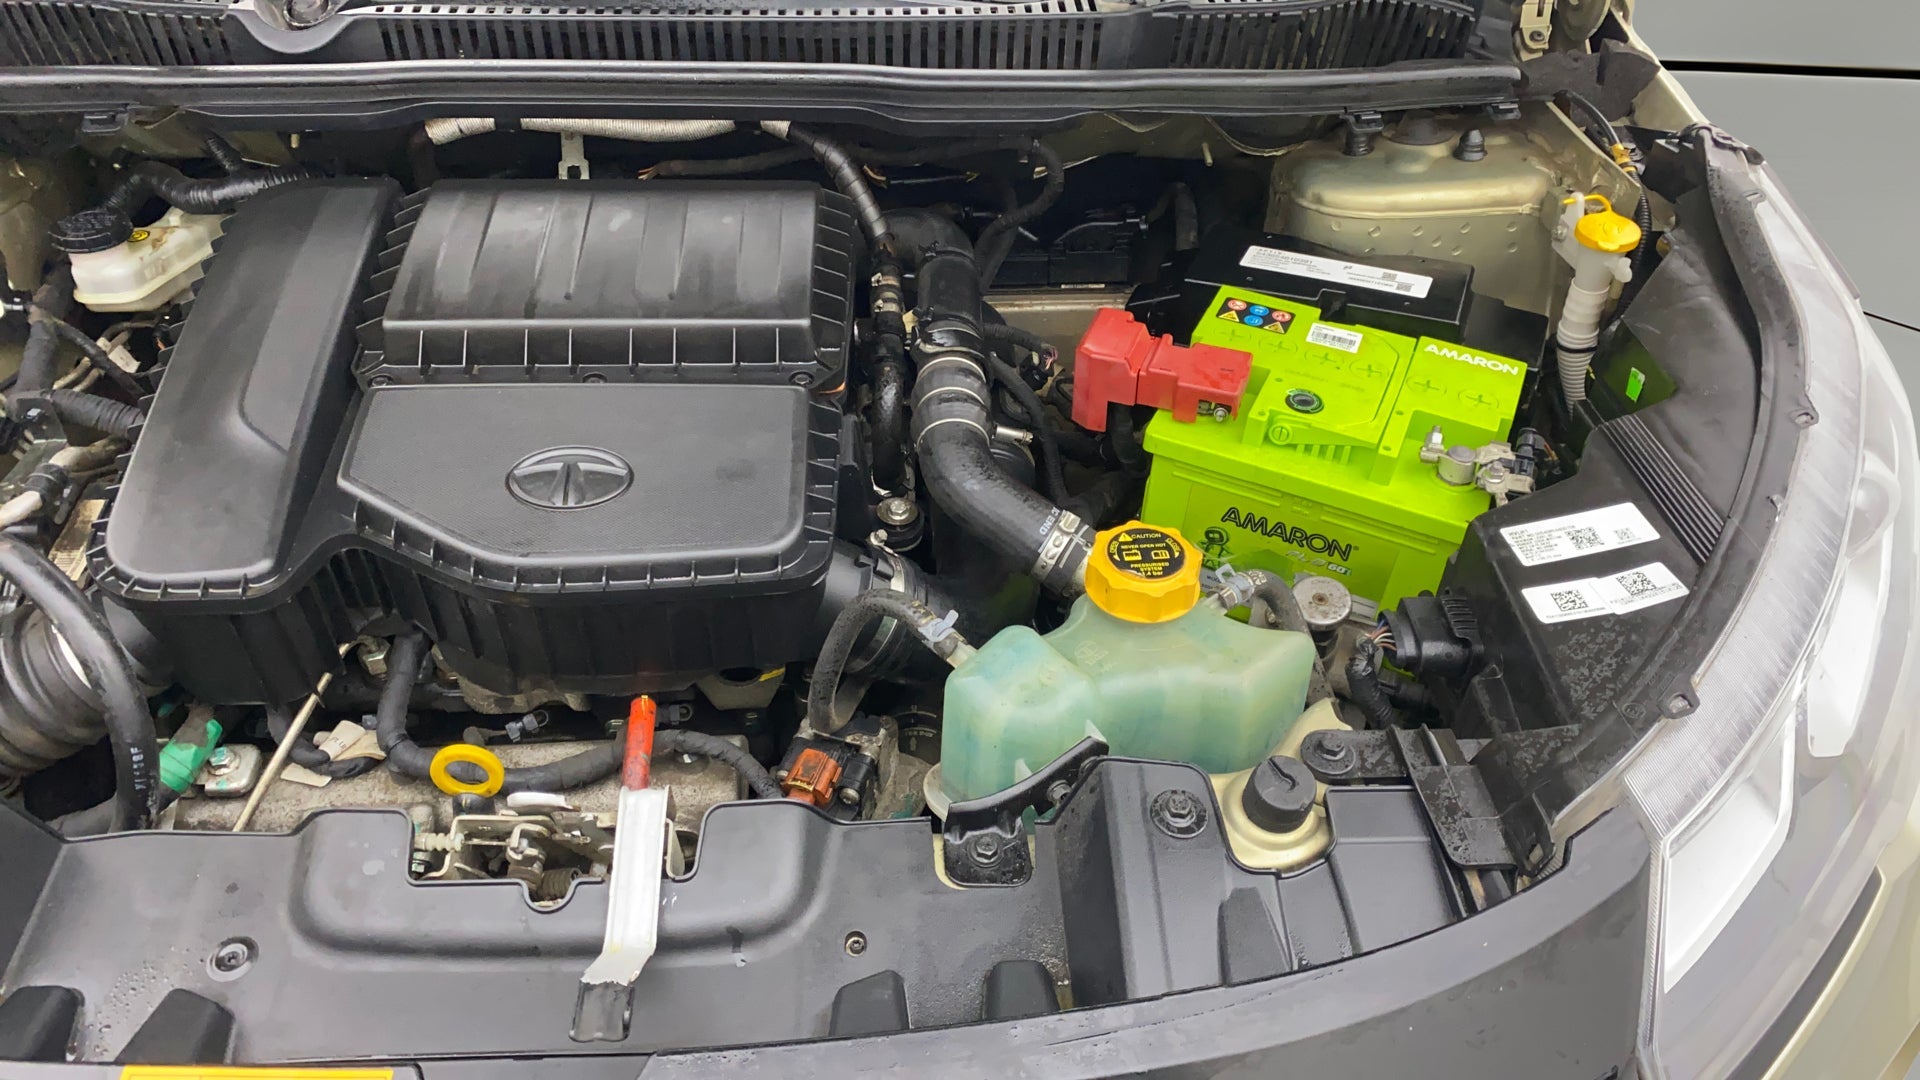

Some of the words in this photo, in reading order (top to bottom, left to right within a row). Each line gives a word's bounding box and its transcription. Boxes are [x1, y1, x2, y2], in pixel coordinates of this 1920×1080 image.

[1424, 344, 1518, 375] AMARON
[1039, 515, 1055, 535] END
[1221, 507, 1352, 561] AMARON
